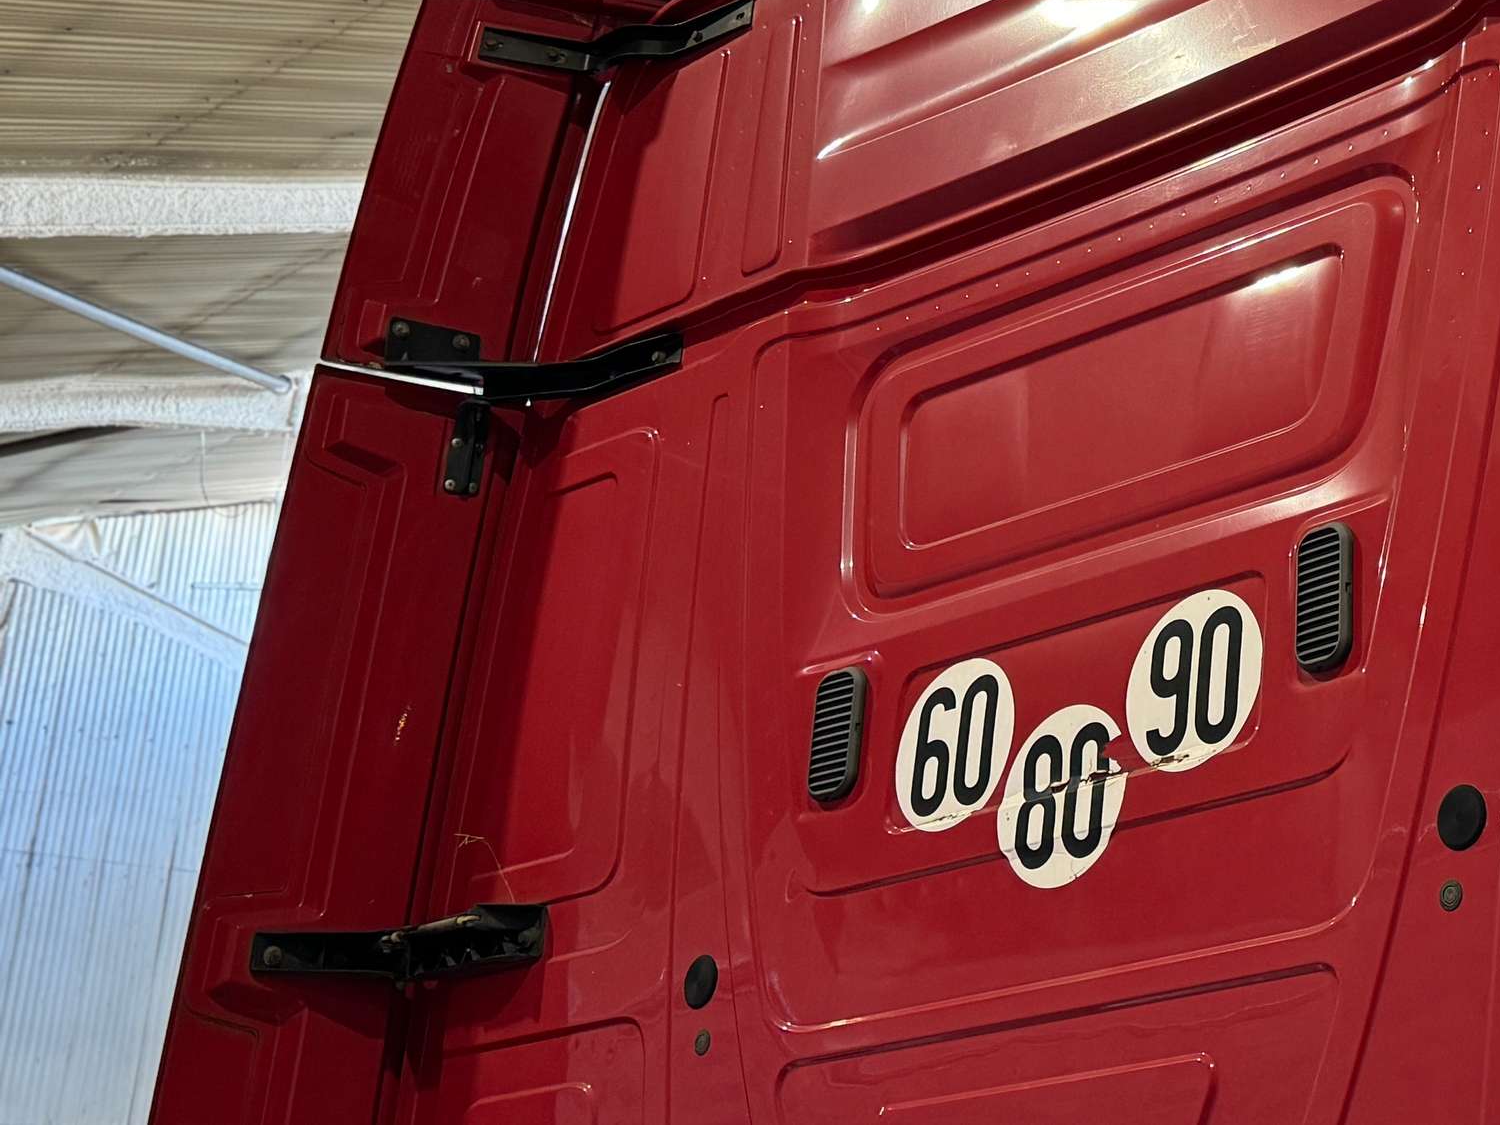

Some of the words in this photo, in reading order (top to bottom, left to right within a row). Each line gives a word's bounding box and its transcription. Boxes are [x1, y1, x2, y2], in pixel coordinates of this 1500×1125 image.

[910, 674, 999, 817] 60
[1146, 606, 1243, 756] 90
[1014, 722, 1110, 870] 80
